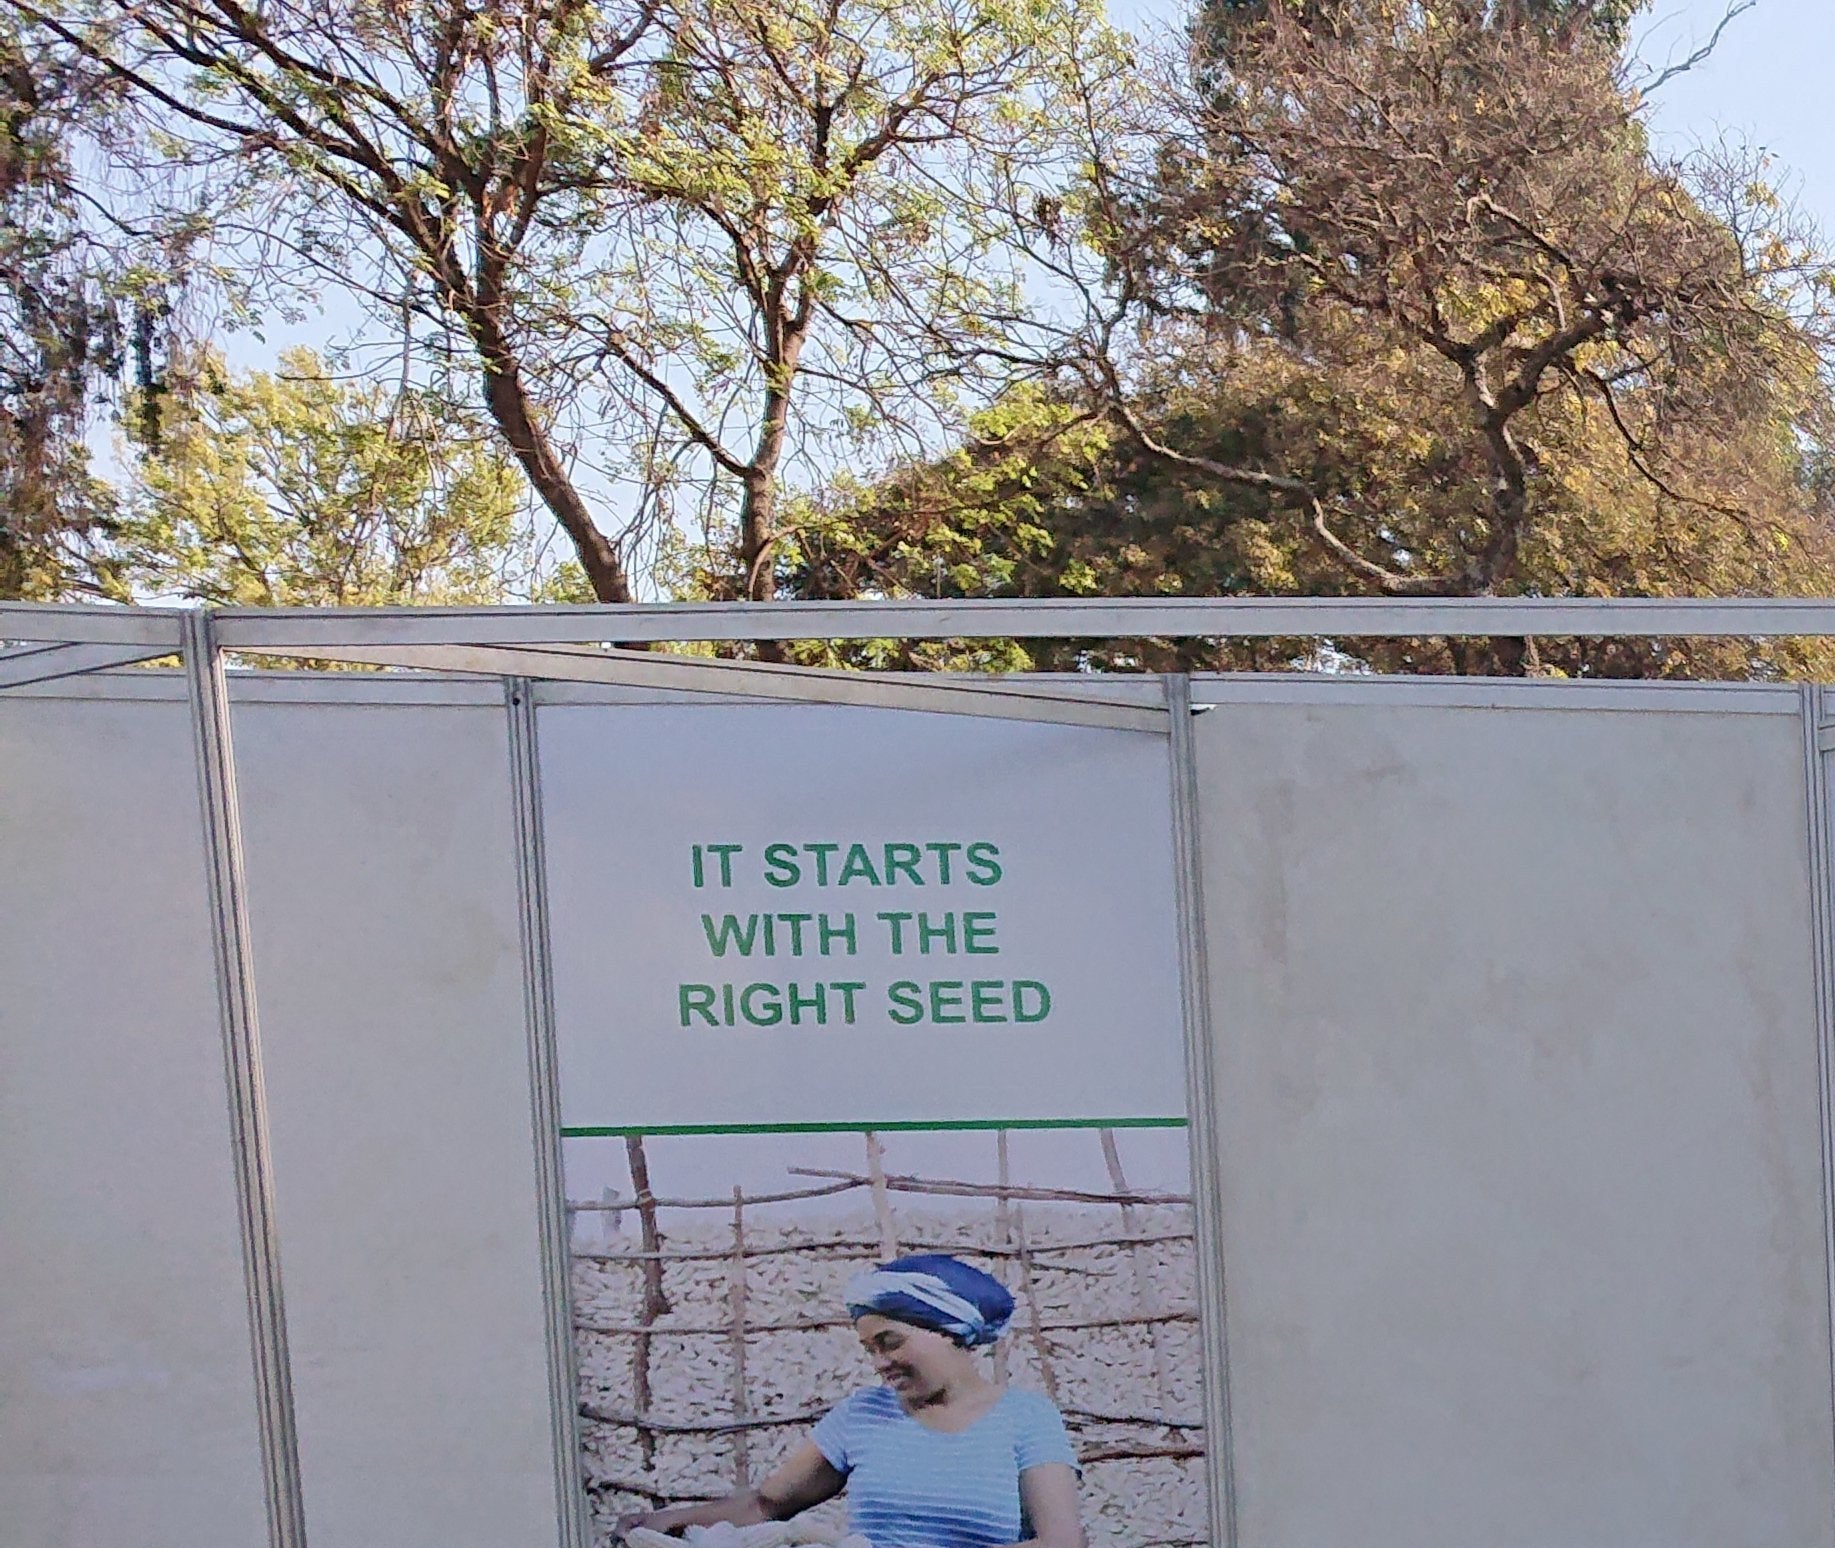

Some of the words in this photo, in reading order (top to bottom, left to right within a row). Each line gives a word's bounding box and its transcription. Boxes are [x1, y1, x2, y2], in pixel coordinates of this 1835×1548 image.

[692, 844, 742, 888] IT
[762, 842, 1003, 888] STARTS
[702, 912, 857, 956] WITH
[877, 911, 1000, 955] THE
[679, 981, 866, 1026] RIGHT
[887, 979, 1051, 1025] SEED
